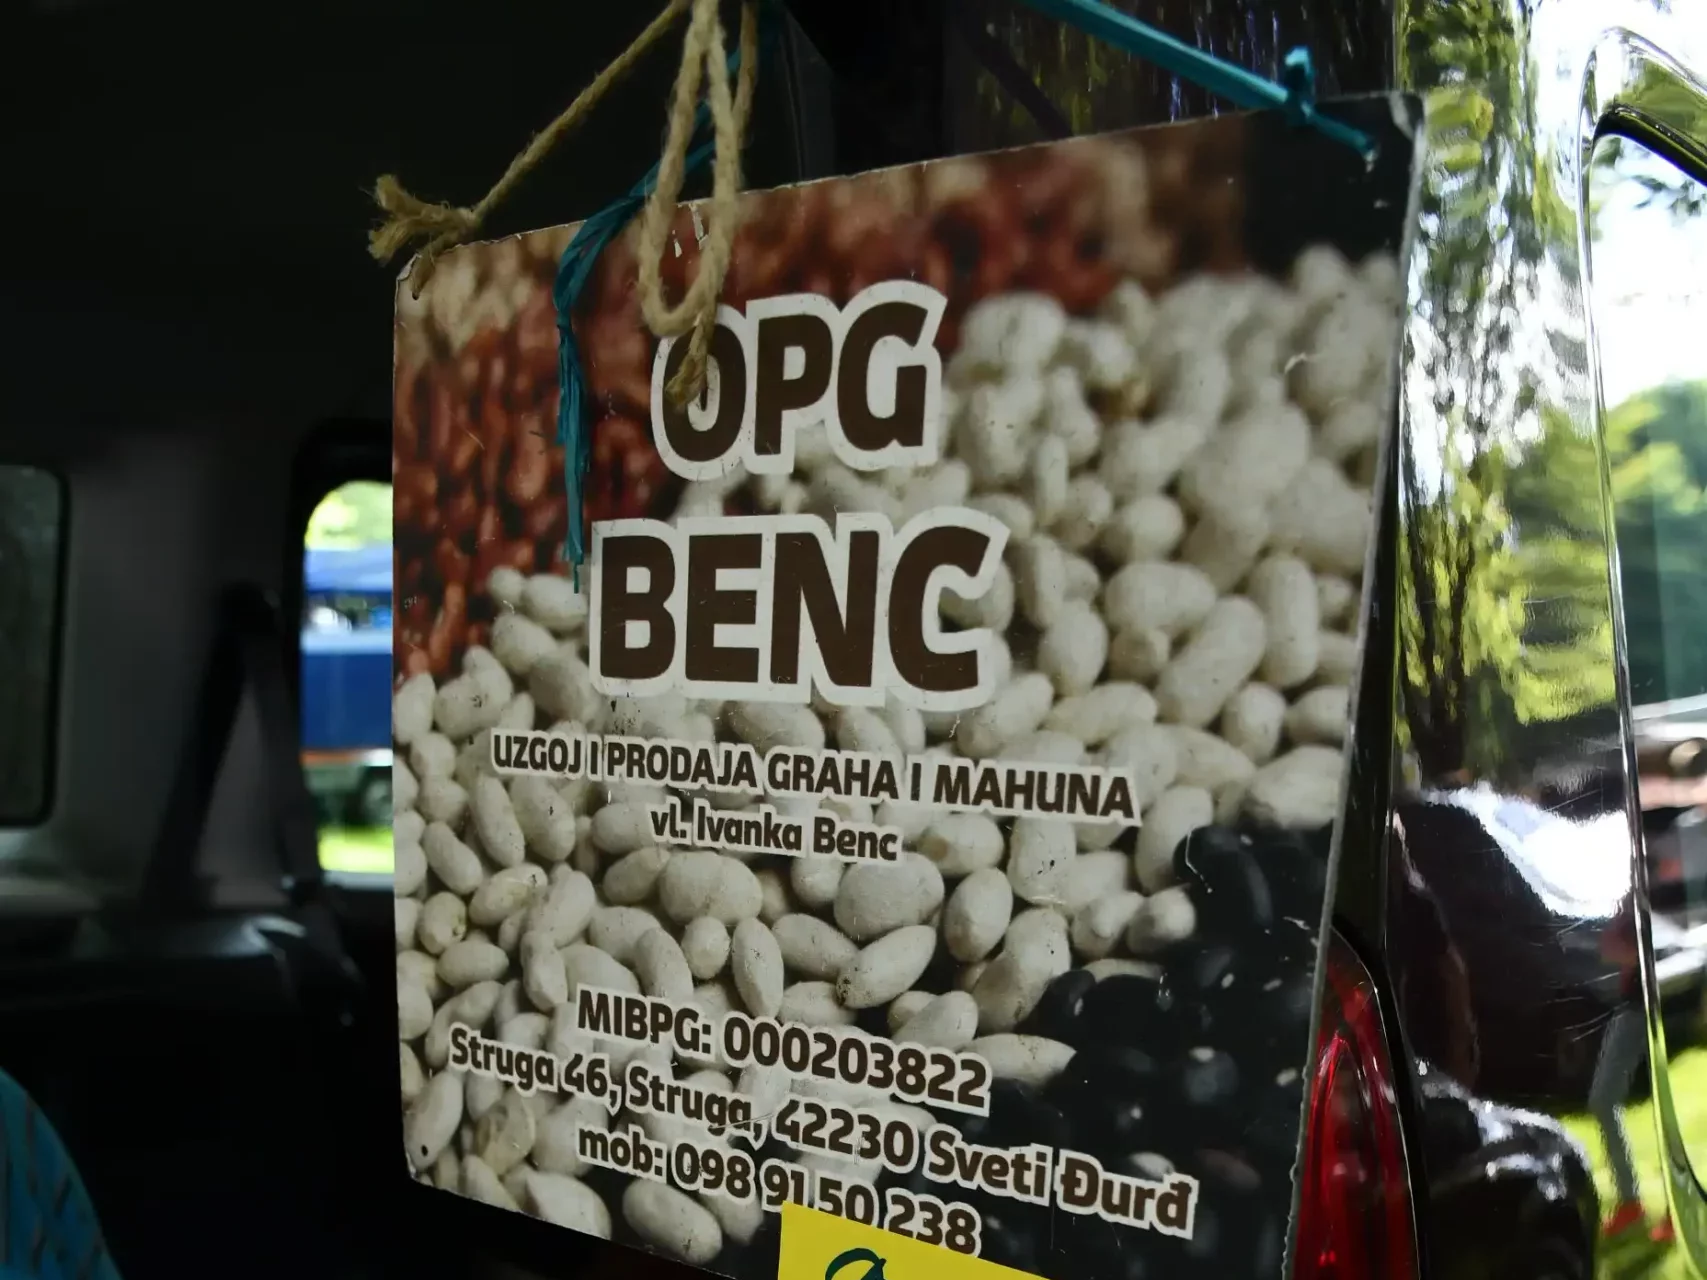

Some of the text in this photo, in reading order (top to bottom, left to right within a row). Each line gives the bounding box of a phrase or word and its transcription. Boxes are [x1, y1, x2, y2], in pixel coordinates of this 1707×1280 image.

[661, 300, 930, 462] OPG
[600, 524, 990, 691] BENC
[494, 735, 1134, 819] UZGOJ I PRODAJA GRAHA I MAHUNA
[651, 803, 898, 861] vl. Ivanka Benc
[578, 989, 987, 1108] MIBPG: 000203822
[451, 1028, 1192, 1230] Struga 46, Struga, 42230 Sveti Đurđ
[579, 1127, 977, 1255] mob: 098 91 50 238
